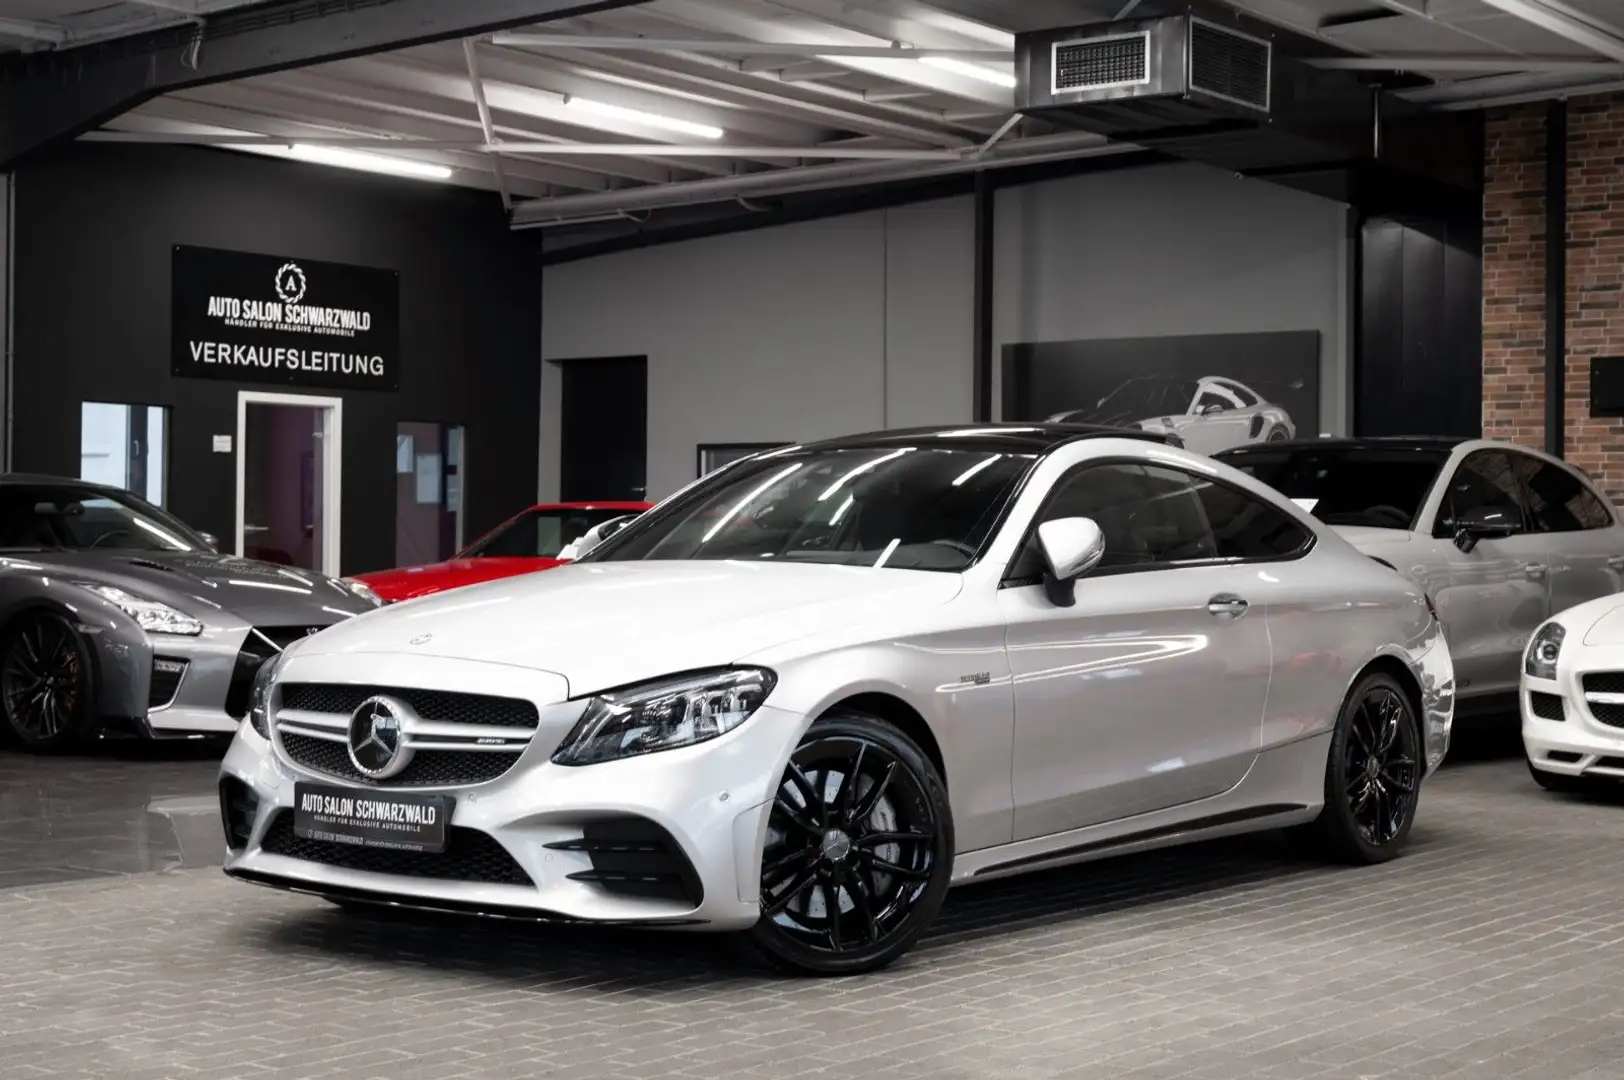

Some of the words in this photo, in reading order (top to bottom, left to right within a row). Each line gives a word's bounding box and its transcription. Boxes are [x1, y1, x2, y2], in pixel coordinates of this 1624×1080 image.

[285, 275, 297, 291] A
[207, 296, 241, 317] AUTO
[242, 300, 282, 322] SALON
[285, 303, 371, 331] SCHWARZWALD
[275, 323, 312, 333] EXKLUSIVE
[313, 327, 355, 337] AUTOMOBILE
[189, 340, 385, 376] VERKAUFSLEITUNG
[301, 793, 323, 813] AUTO
[324, 795, 354, 817] SALON
[355, 799, 436, 825] SCHWARZWALD
[349, 819, 380, 829] EXKLUSIVE
[381, 823, 421, 833] AUTOMOBILE
